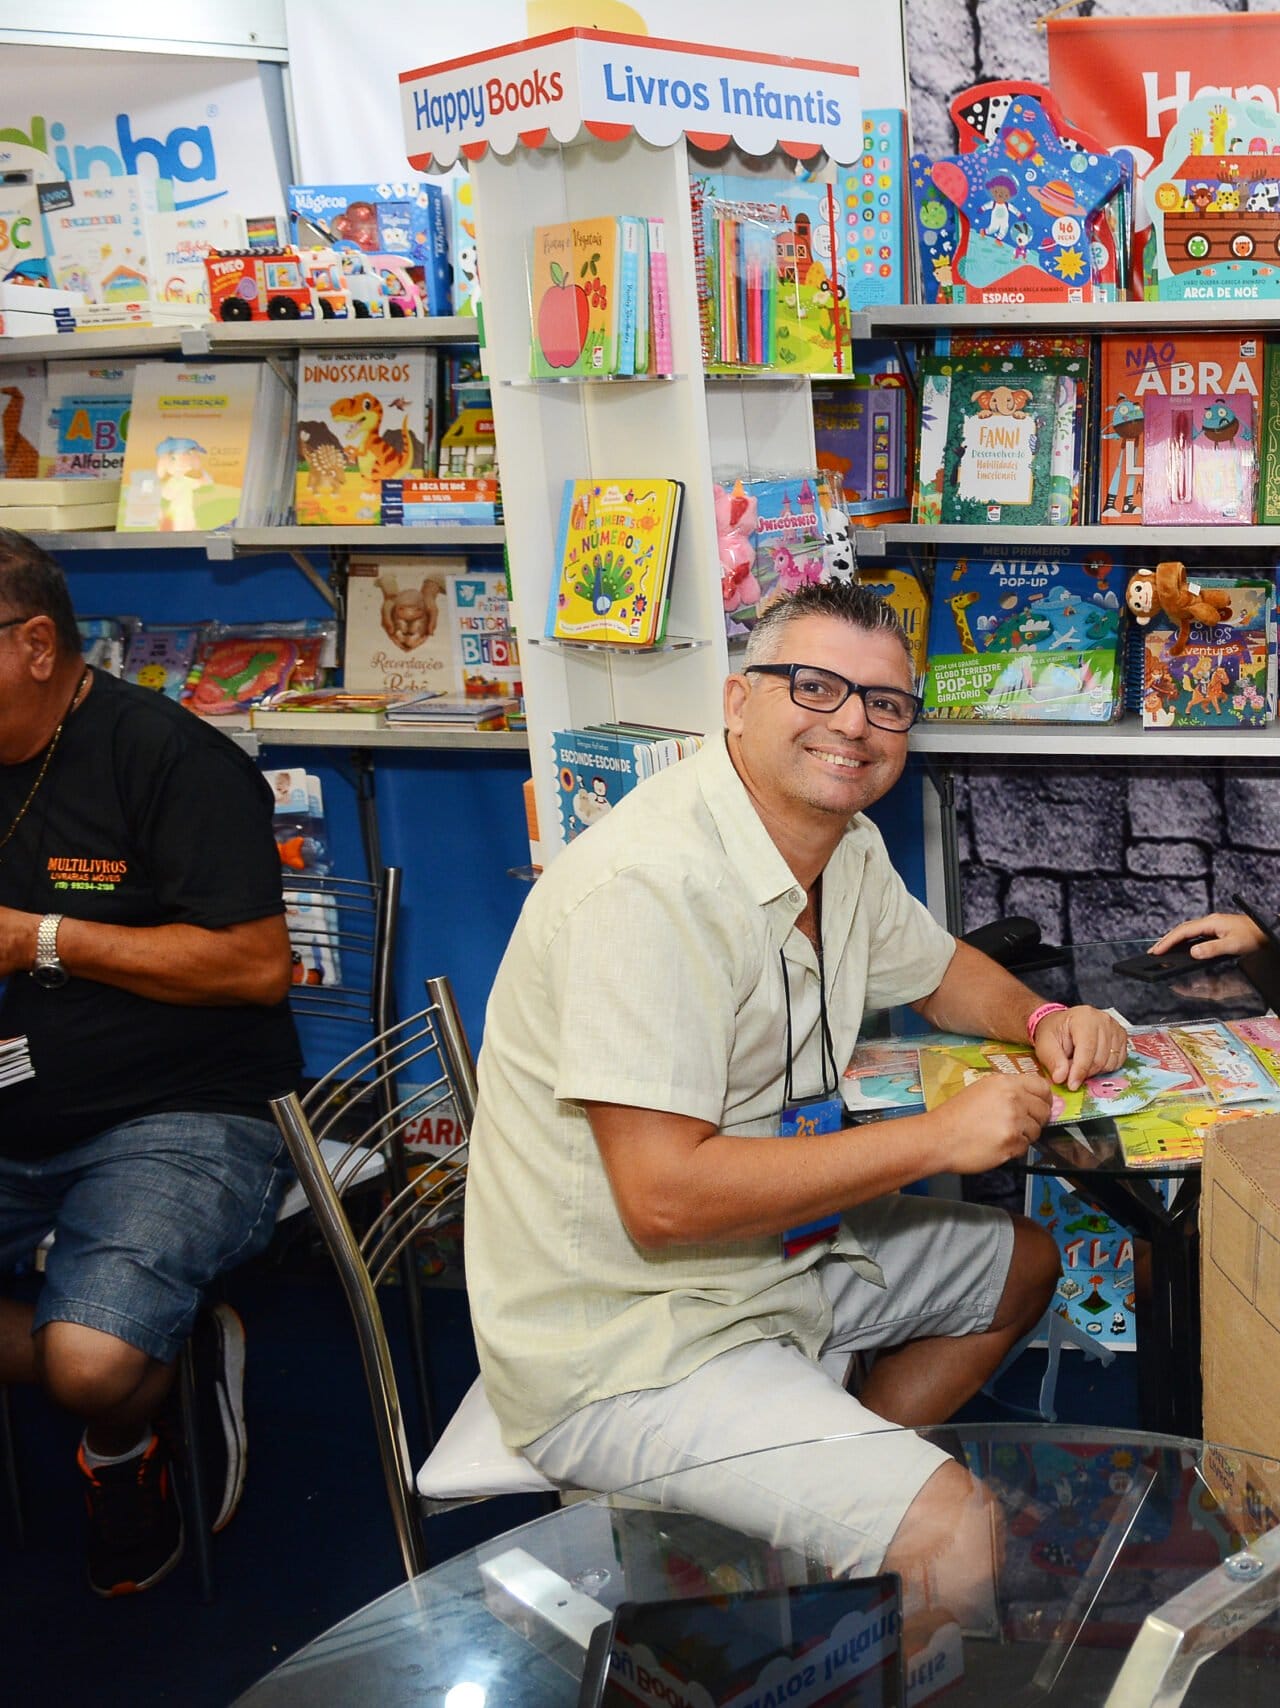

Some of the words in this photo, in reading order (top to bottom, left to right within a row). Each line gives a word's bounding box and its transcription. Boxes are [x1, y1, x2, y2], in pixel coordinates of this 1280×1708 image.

[603, 63, 710, 111] Livros
[719, 78, 842, 126] Infantis
[1058, 221, 1073, 234] 46
[211, 260, 245, 276] THEO
[1184, 288, 1215, 299] ARCA
[1217, 288, 1232, 299] DE
[1234, 286, 1259, 299] NOÉ
[304, 364, 411, 383] DINOSSAUROS
[1135, 362, 1259, 396] ABRA
[979, 426, 1020, 449] FANNI
[582, 530, 641, 554] NÚMEROS
[983, 547, 1010, 556] MEU
[1013, 547, 1070, 556] PRIMEIRO
[989, 560, 1061, 576] ATLAS
[999, 578, 1049, 587] POP-UP
[1185, 645, 1239, 656] venturas
[935, 670, 960, 681] GLOBO
[961, 663, 1001, 676] TERRESTRE
[936, 673, 993, 694] POP-UP
[937, 689, 981, 703] GIRATÓRIO
[560, 748, 632, 773] ESCONDE-ESCONDE
[47, 858, 127, 873] MULTILIVROS
